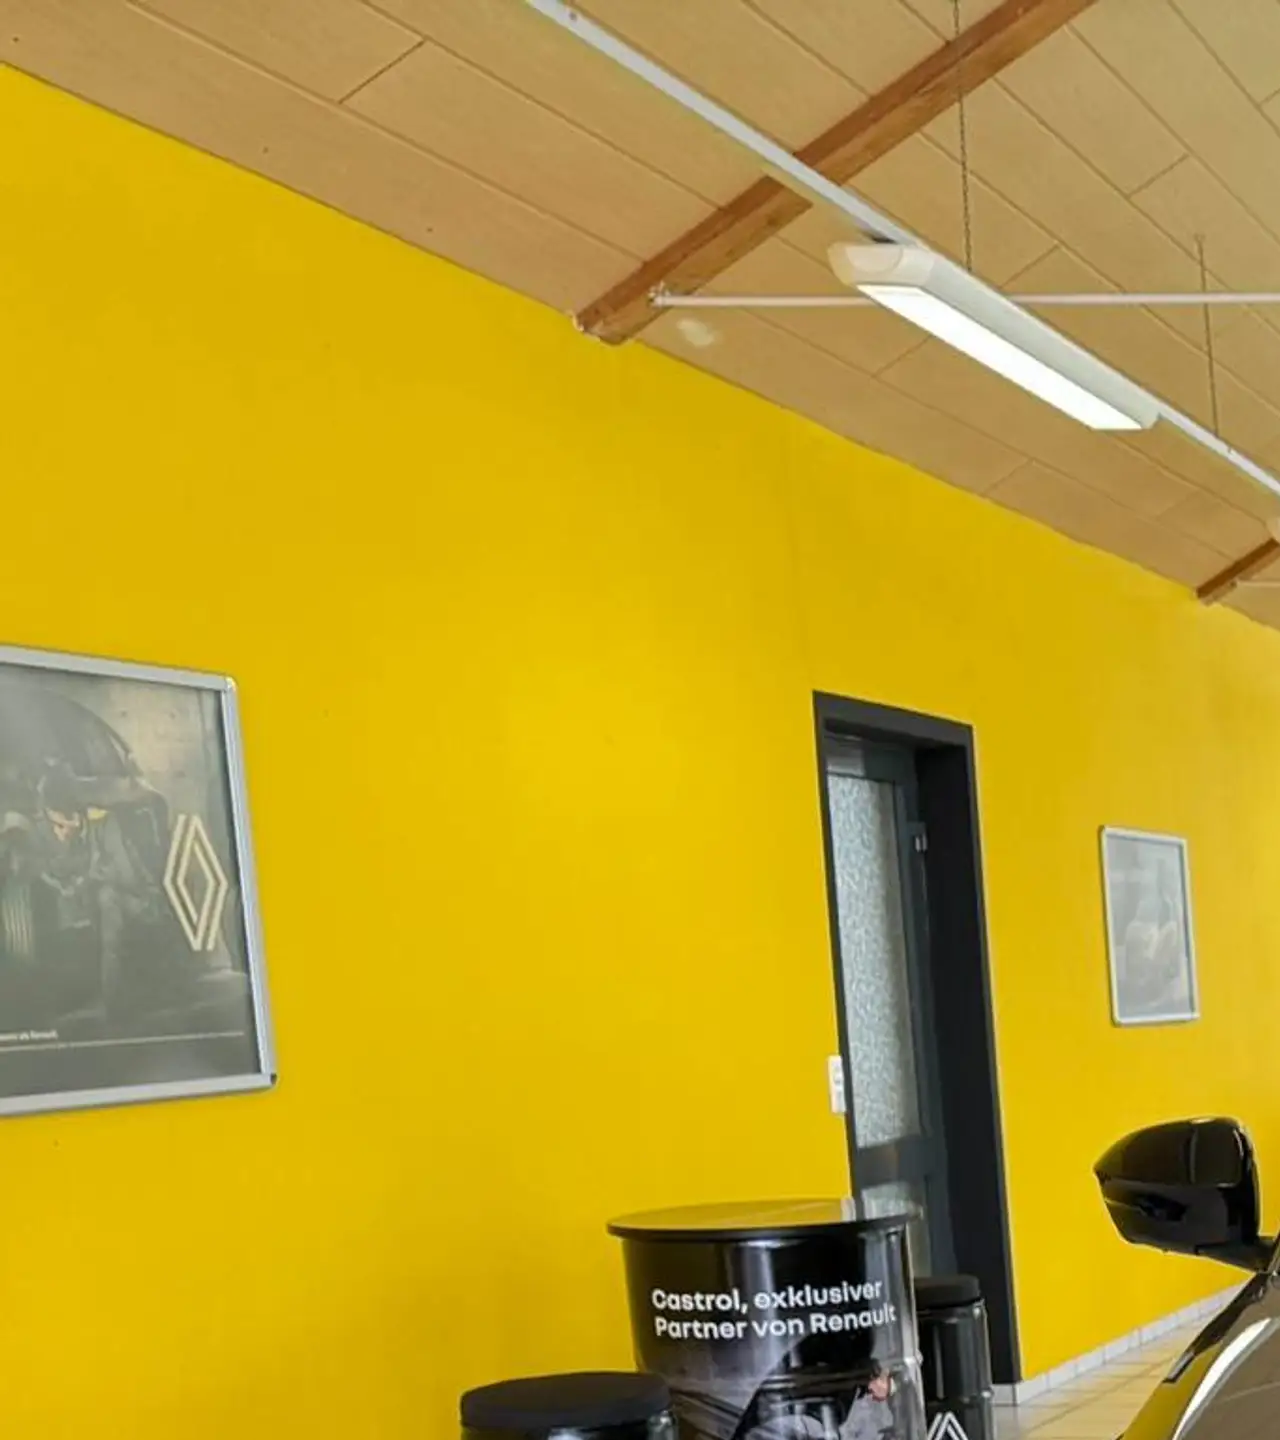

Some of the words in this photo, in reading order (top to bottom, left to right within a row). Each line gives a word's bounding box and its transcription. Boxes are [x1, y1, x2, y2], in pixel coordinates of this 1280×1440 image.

[652, 1288, 748, 1314] Castrol,
[753, 1280, 883, 1309] exklusiver
[655, 1315, 747, 1339] Partner
[752, 1319, 804, 1338] von
[809, 1302, 897, 1334] Renault
